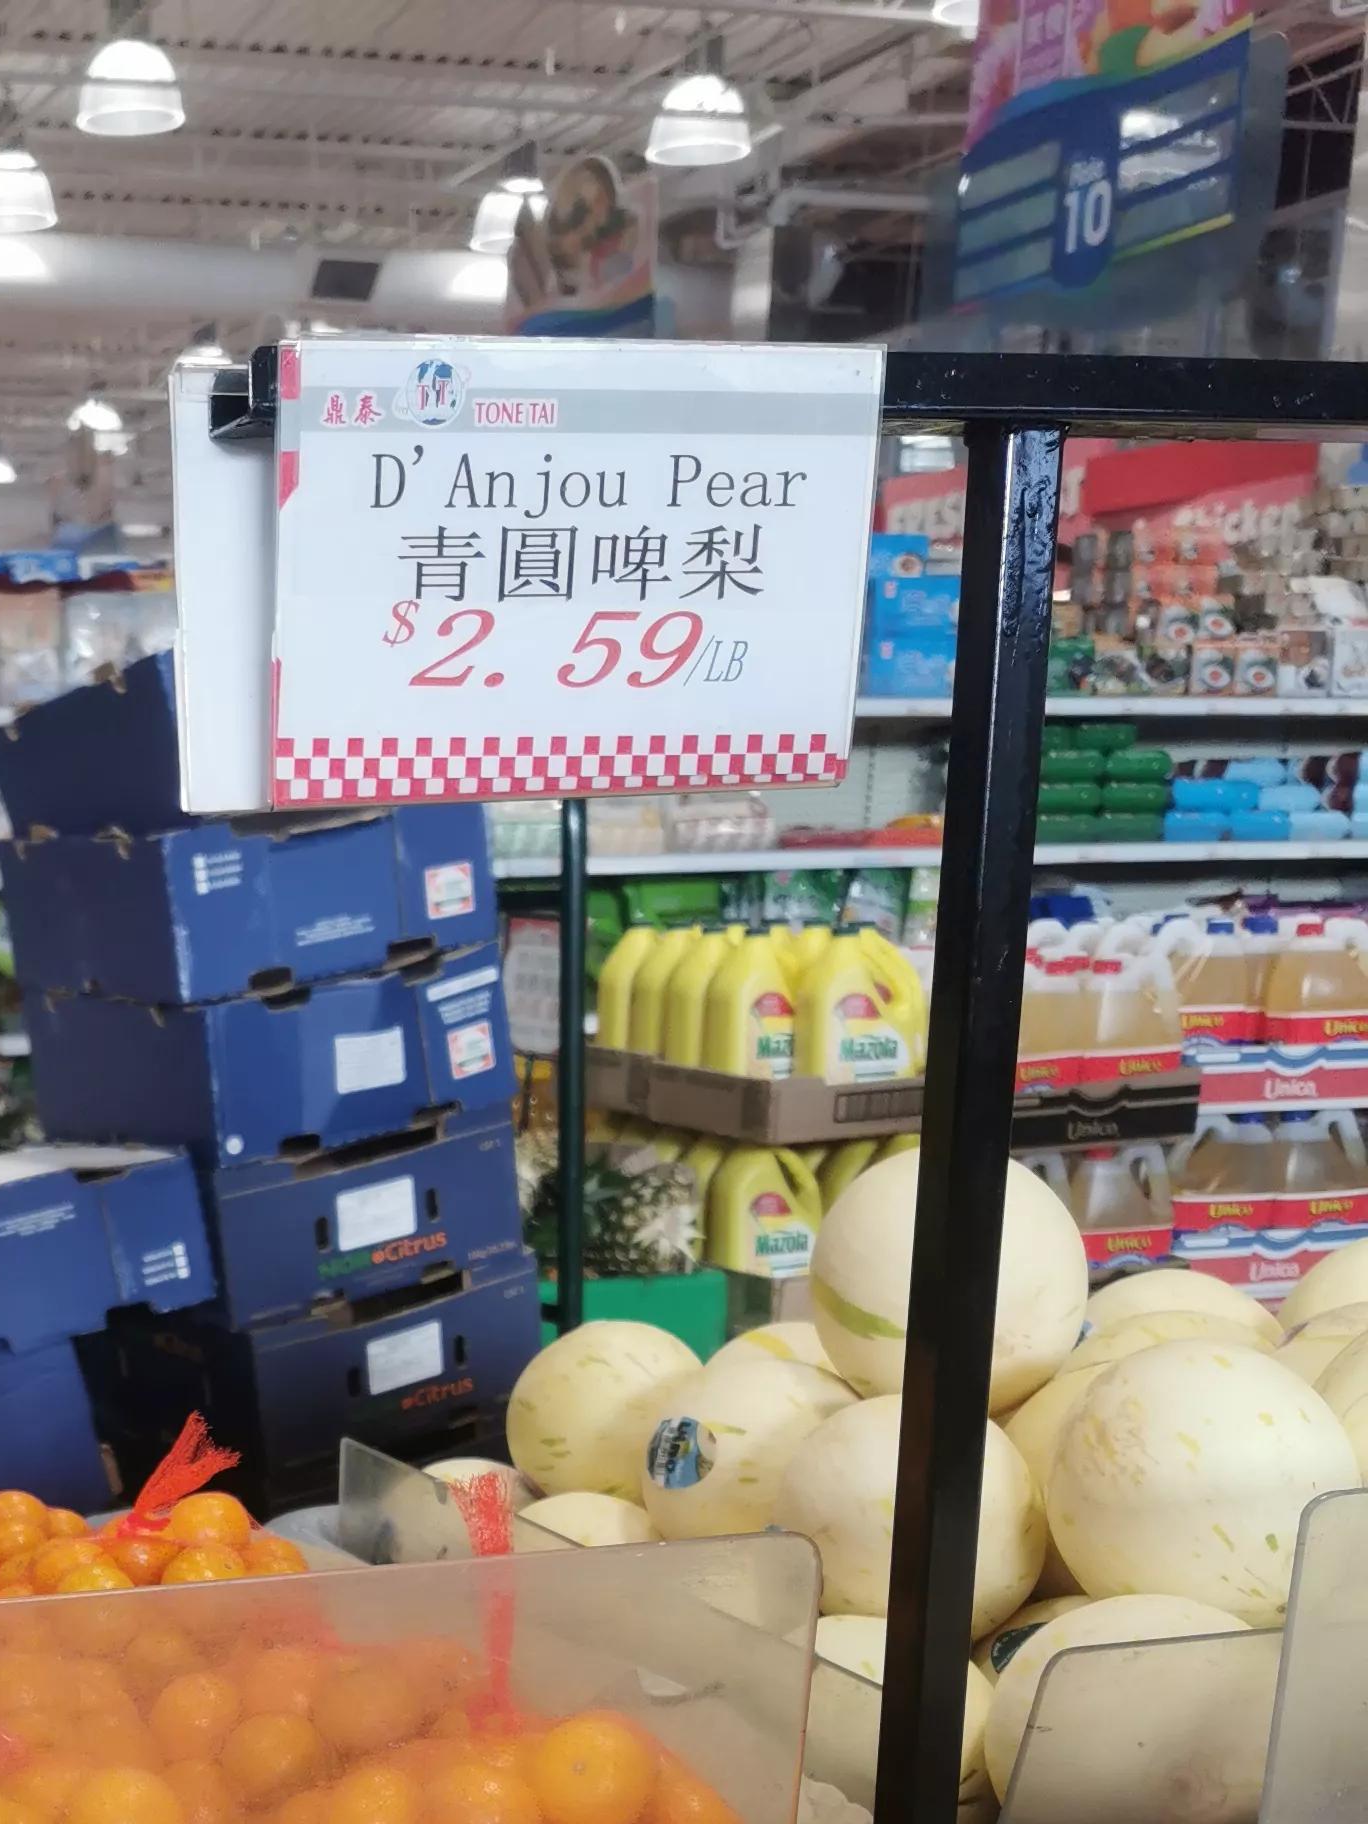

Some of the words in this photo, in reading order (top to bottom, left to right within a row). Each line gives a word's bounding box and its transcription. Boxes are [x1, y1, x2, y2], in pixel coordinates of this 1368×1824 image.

[1064, 179, 1112, 254] 10
[475, 402, 524, 425] TONE
[528, 402, 555, 425] TAI
[666, 453, 809, 509] Pear
[396, 523, 765, 603] 青圓啤梨
